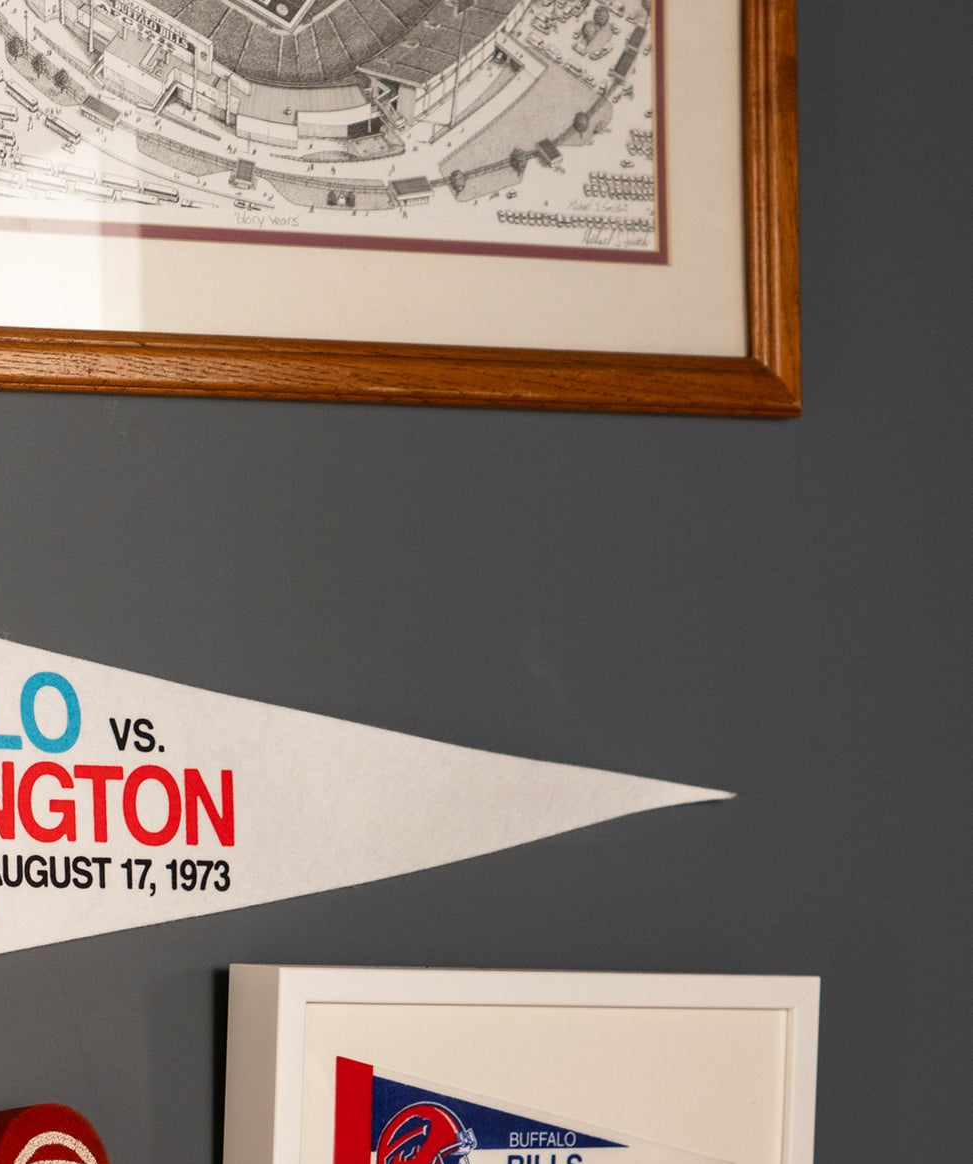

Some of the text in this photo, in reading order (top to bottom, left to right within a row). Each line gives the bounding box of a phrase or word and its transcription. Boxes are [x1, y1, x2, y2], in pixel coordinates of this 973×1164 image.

[109, 717, 165, 753] VS.
[122, 859, 157, 897] 17,
[165, 859, 232, 891] 1973
[509, 1131, 576, 1148] BUFFALO
